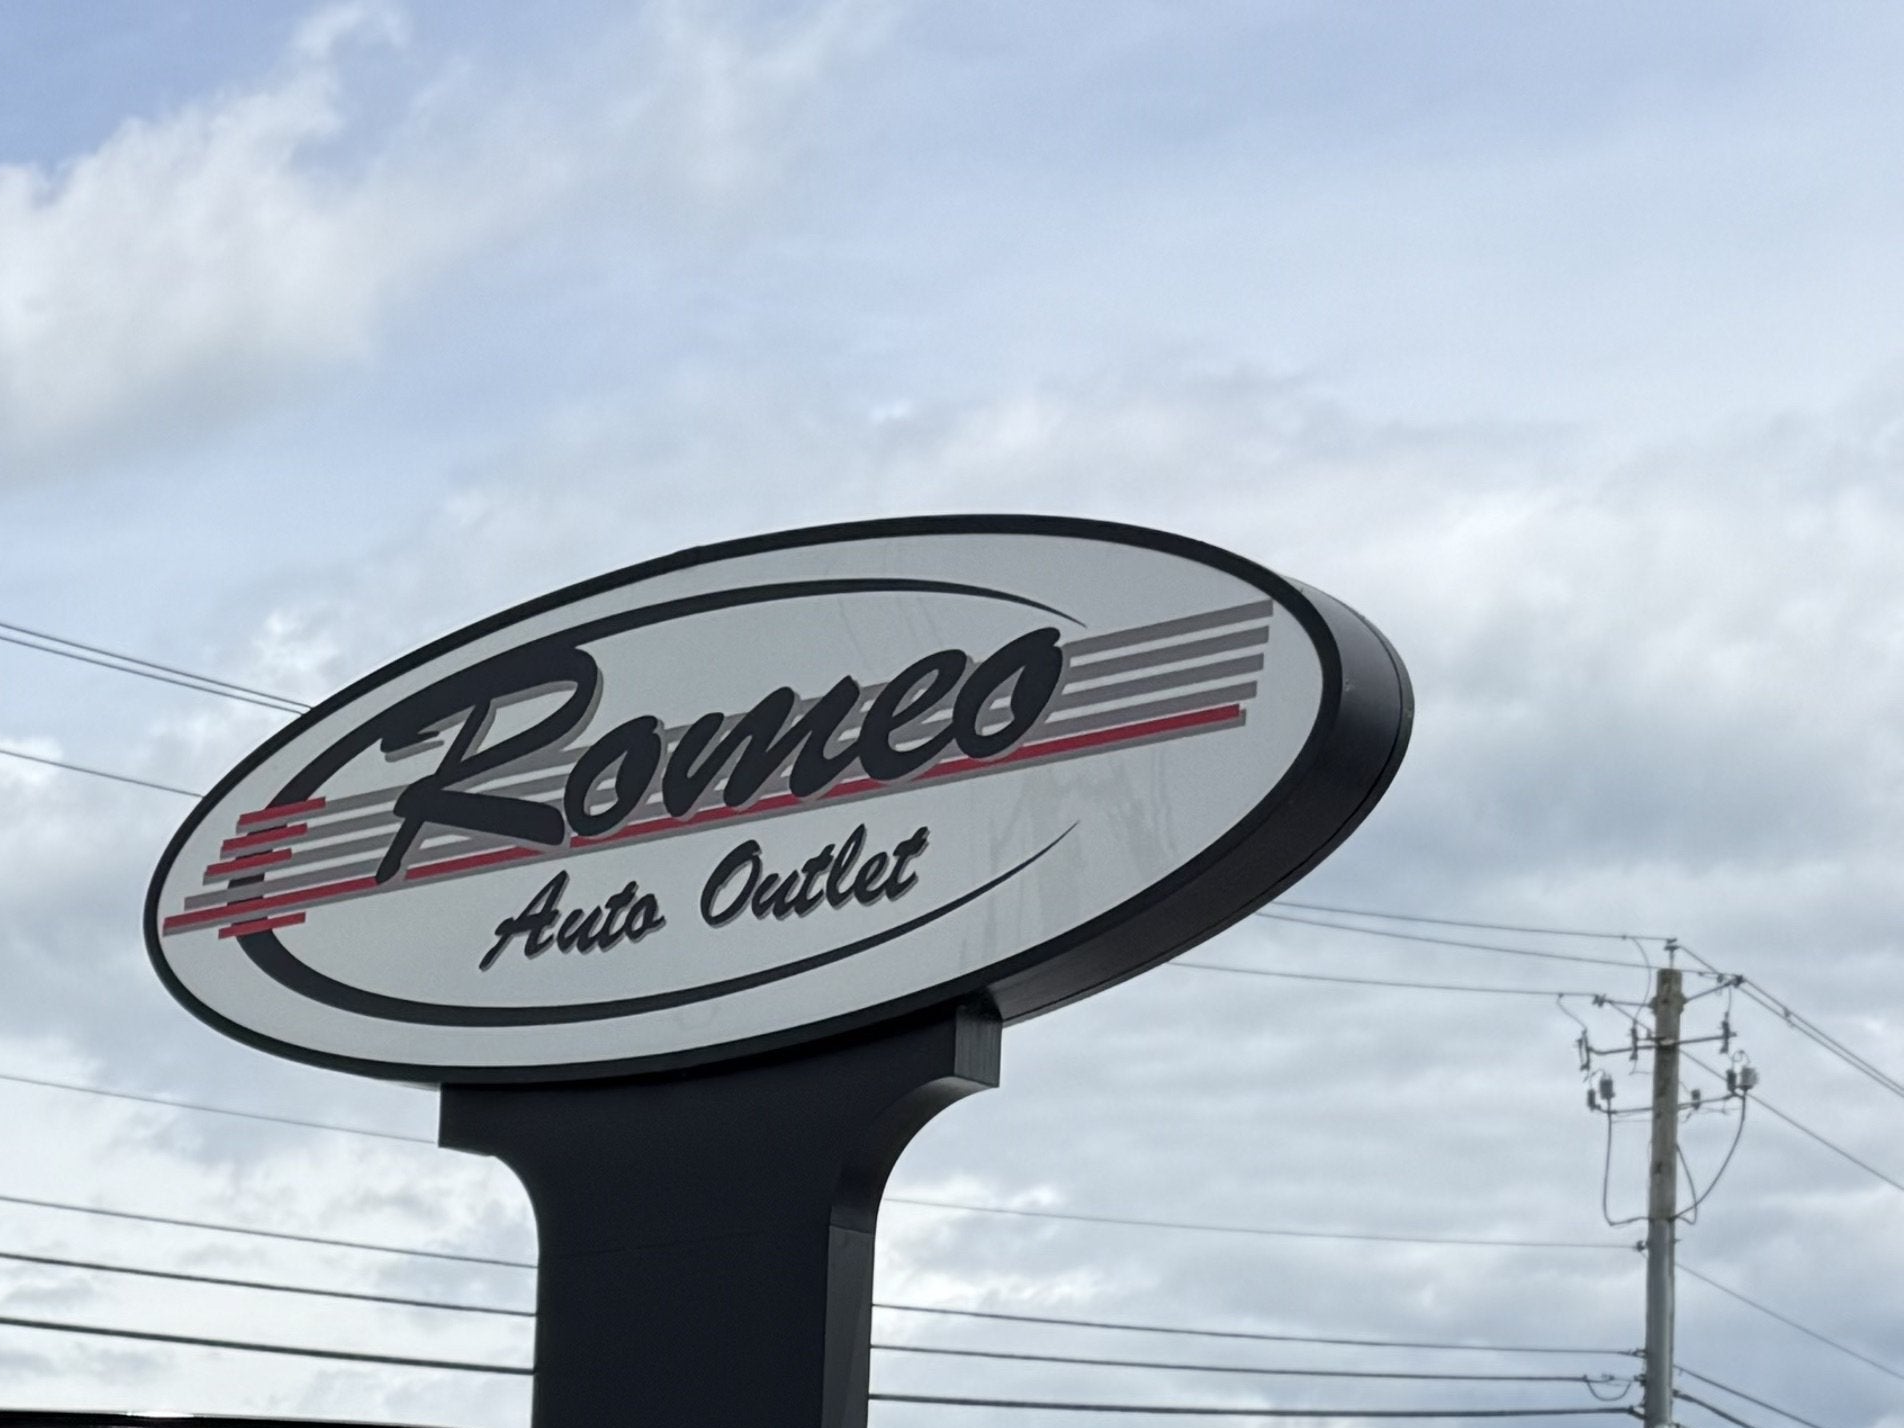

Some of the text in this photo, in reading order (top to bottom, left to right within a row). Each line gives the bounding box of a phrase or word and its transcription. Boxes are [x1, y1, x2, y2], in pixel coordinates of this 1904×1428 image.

[376, 627, 1063, 884] Romeo
[479, 823, 930, 972] Auto Outlet
